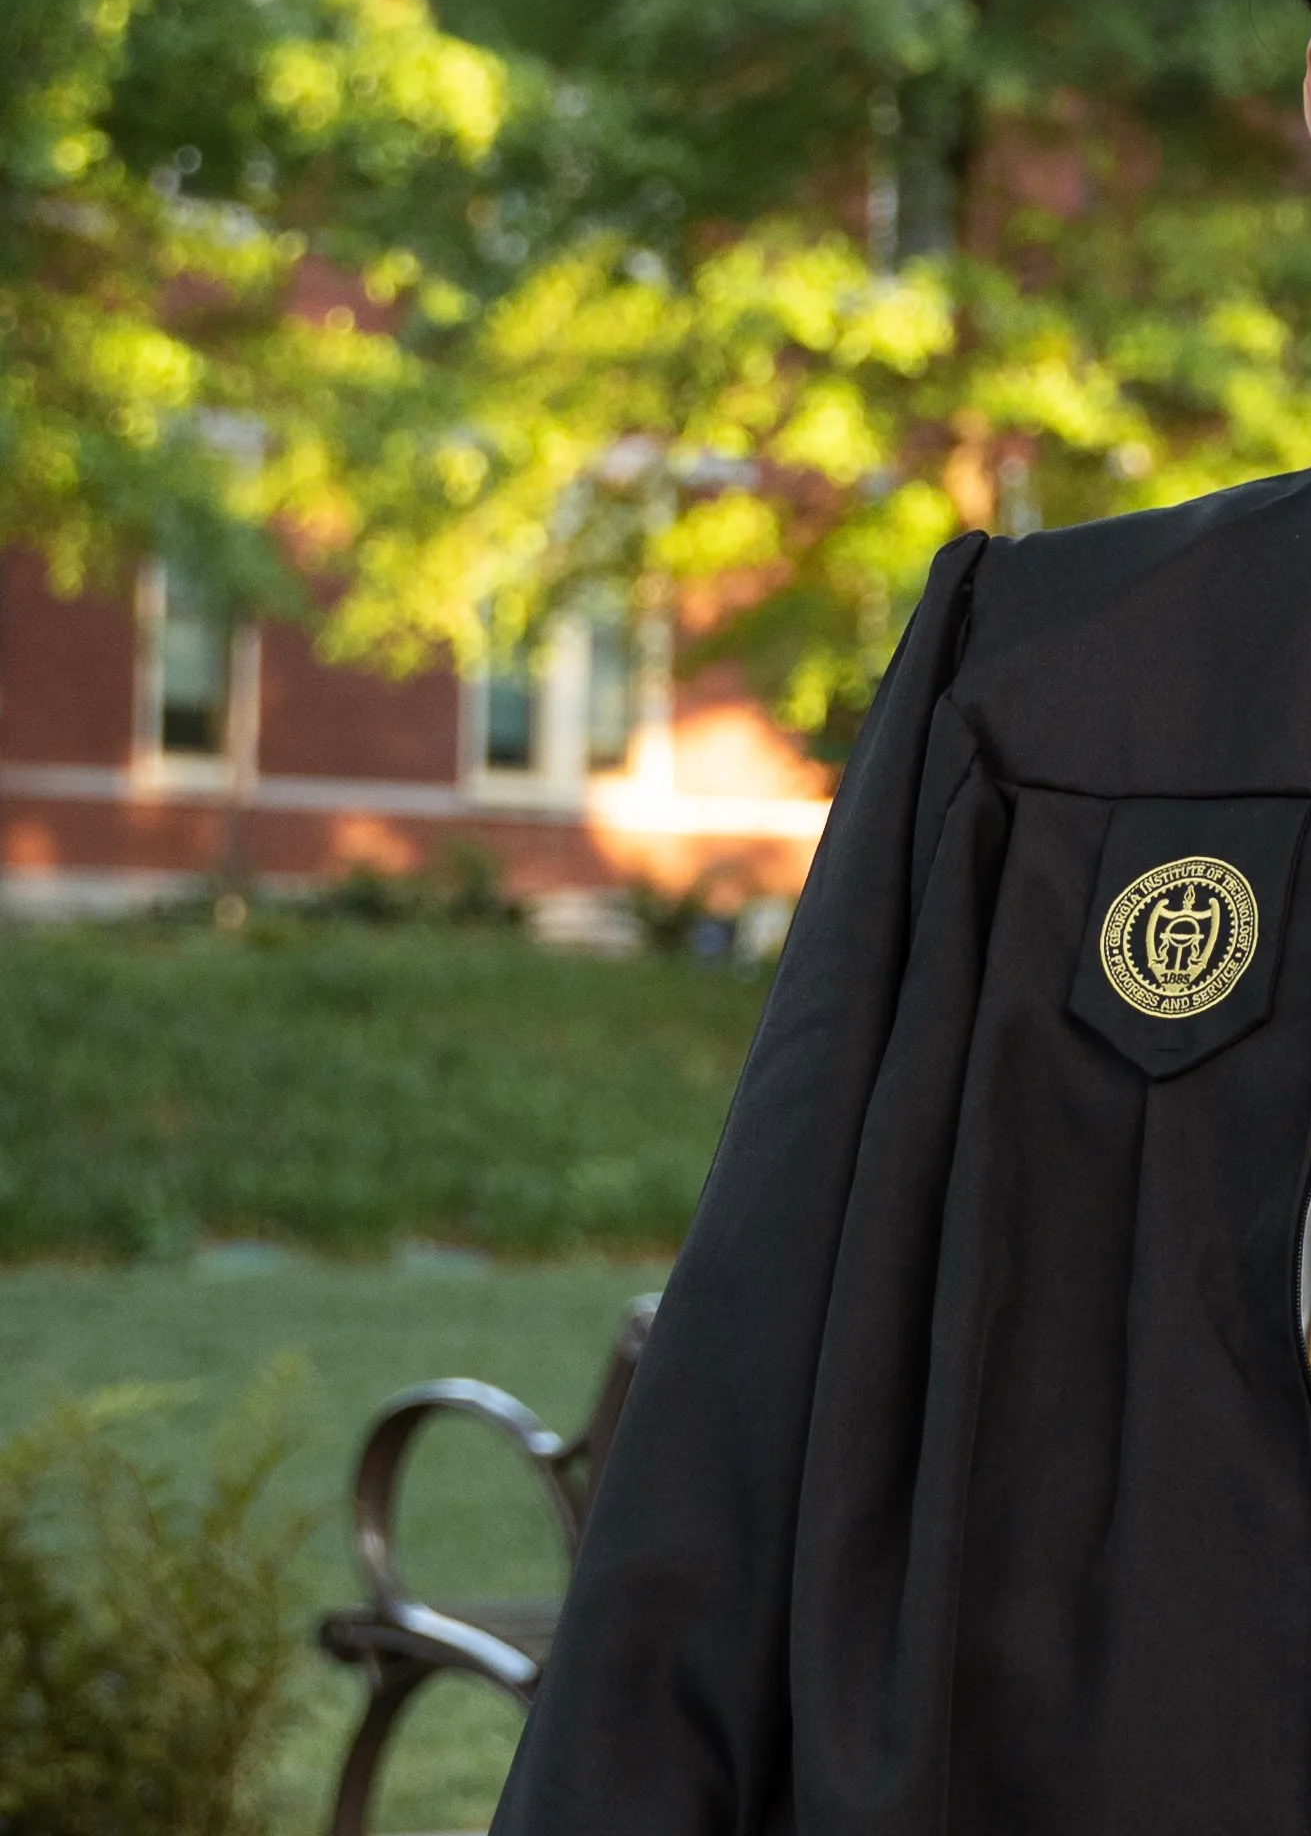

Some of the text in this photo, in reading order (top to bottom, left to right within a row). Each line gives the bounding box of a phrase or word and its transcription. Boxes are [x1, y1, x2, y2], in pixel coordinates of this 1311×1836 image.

[1110, 865, 1251, 951] GEORGIA INSTITUTE OF TECHNOLOGY
[1112, 956, 1240, 1011] PROGRESS AND SERVICE
